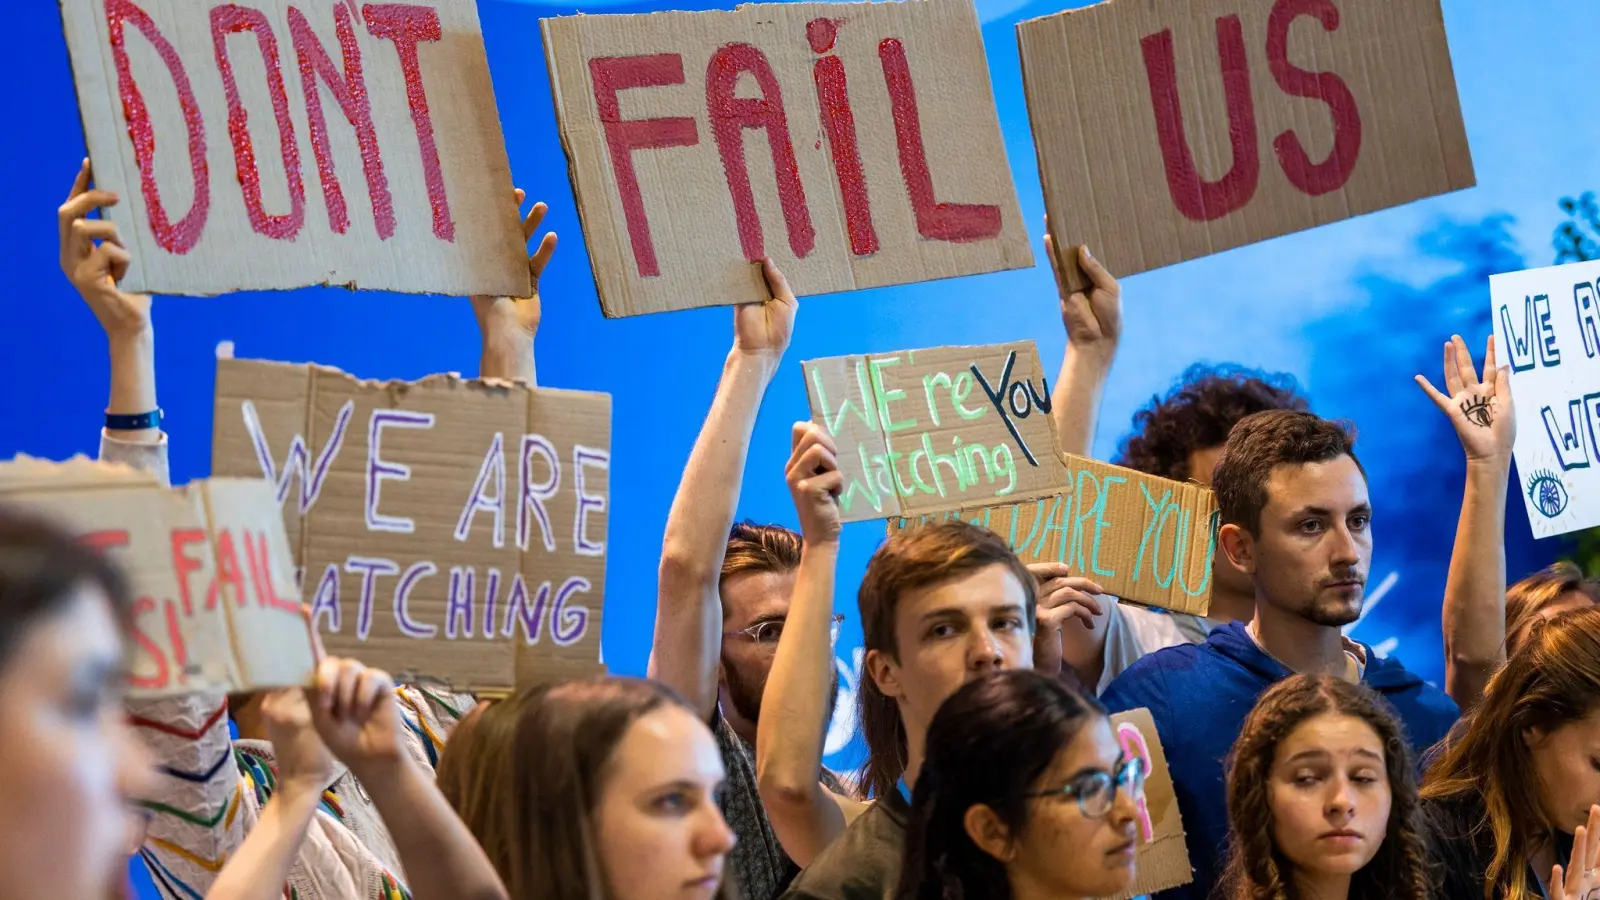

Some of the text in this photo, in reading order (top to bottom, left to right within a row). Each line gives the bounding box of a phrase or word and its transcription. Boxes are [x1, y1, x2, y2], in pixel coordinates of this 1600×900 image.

[107, 0, 456, 255] DON'T
[1140, 0, 1362, 222] US
[1500, 294, 1561, 375] WE
[241, 399, 608, 556] WE ARE
[170, 527, 302, 618] FAIL
[1133, 481, 1220, 597] YOU
[124, 595, 190, 690] S!
[296, 556, 592, 647] ATCHING
